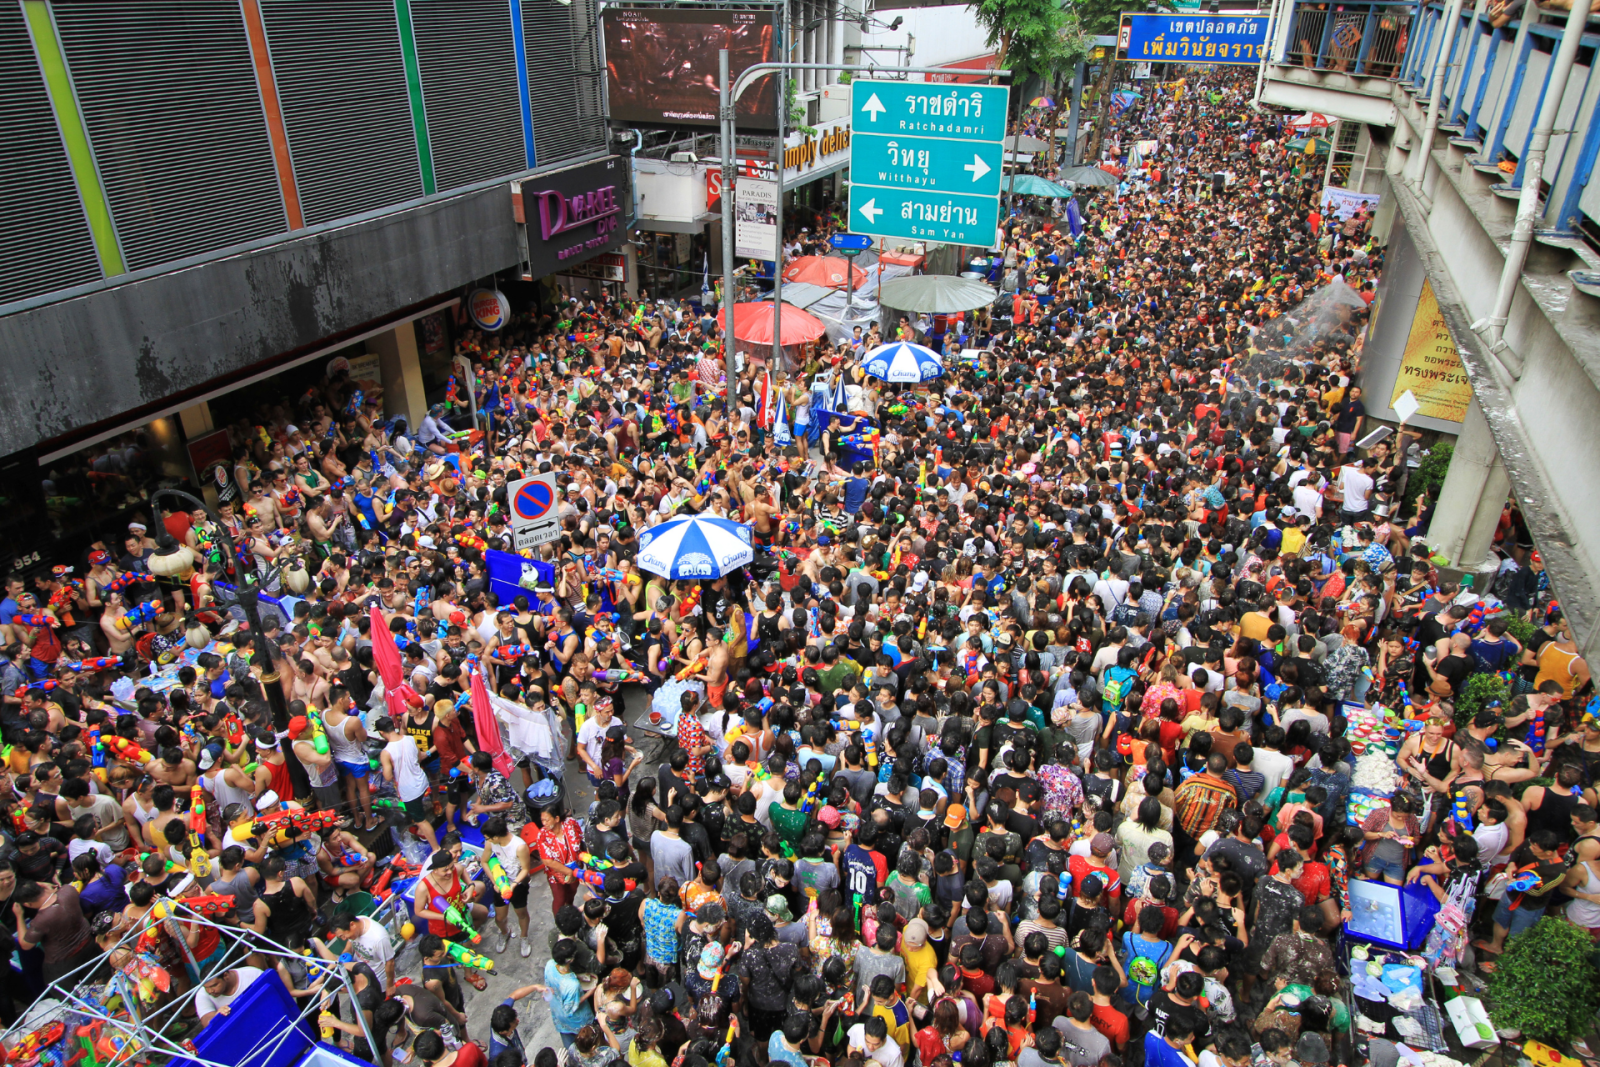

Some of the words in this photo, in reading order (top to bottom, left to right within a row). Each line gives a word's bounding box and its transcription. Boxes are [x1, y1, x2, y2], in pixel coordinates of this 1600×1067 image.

[1169, 18, 1258, 34] เขตปลอดภัย
[905, 90, 983, 118] ราชดำริ
[900, 120, 984, 134] Ratchadamri
[773, 135, 818, 172] imply
[887, 140, 930, 176] วิทยุ
[878, 172, 936, 186] Witthayu
[742, 190, 772, 198] PARADIS
[901, 200, 977, 226] สามย่าน
[911, 226, 936, 236] Sam
[943, 228, 964, 240] Yan
[862, 237, 867, 245] 2
[473, 298, 498, 310] BURGER
[476, 306, 500, 319] KING
[892, 370, 916, 378] Chang
[518, 530, 558, 546] ตลอดเวลา
[14, 551, 41, 570] 954
[642, 553, 667, 572] Chang
[722, 550, 748, 566] Chang
[407, 727, 431, 736] OSAKA
[850, 868, 867, 894] 10
